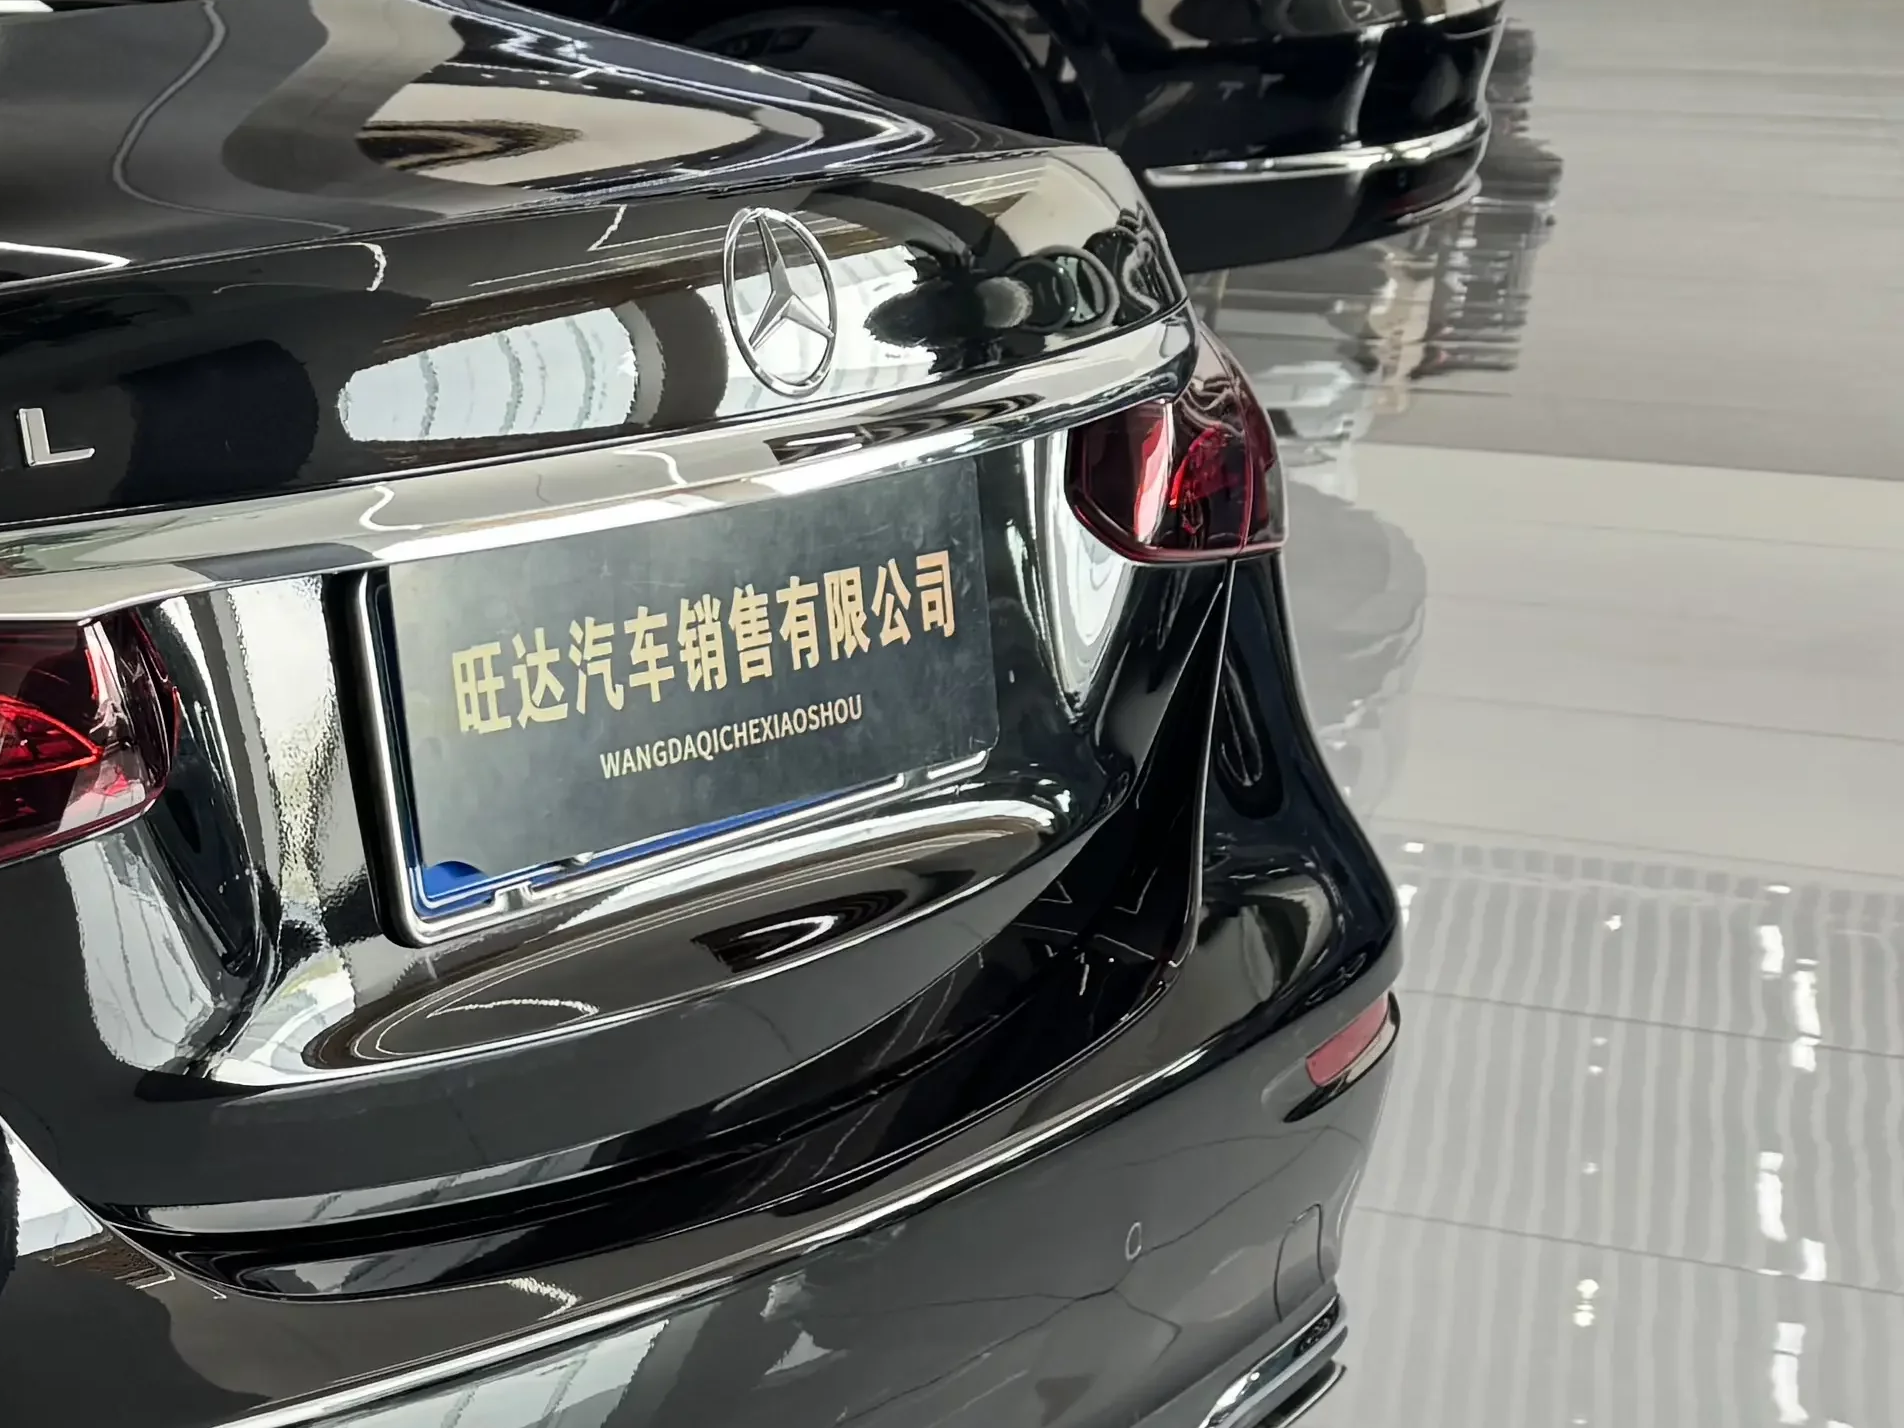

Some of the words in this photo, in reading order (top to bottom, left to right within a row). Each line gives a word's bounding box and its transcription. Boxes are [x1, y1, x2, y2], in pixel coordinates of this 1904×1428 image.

[15, 407, 96, 468] L
[451, 548, 956, 735] 旺达汽车销售有限公司
[599, 693, 864, 780] WANGDAQICHEXIAOSHOU
